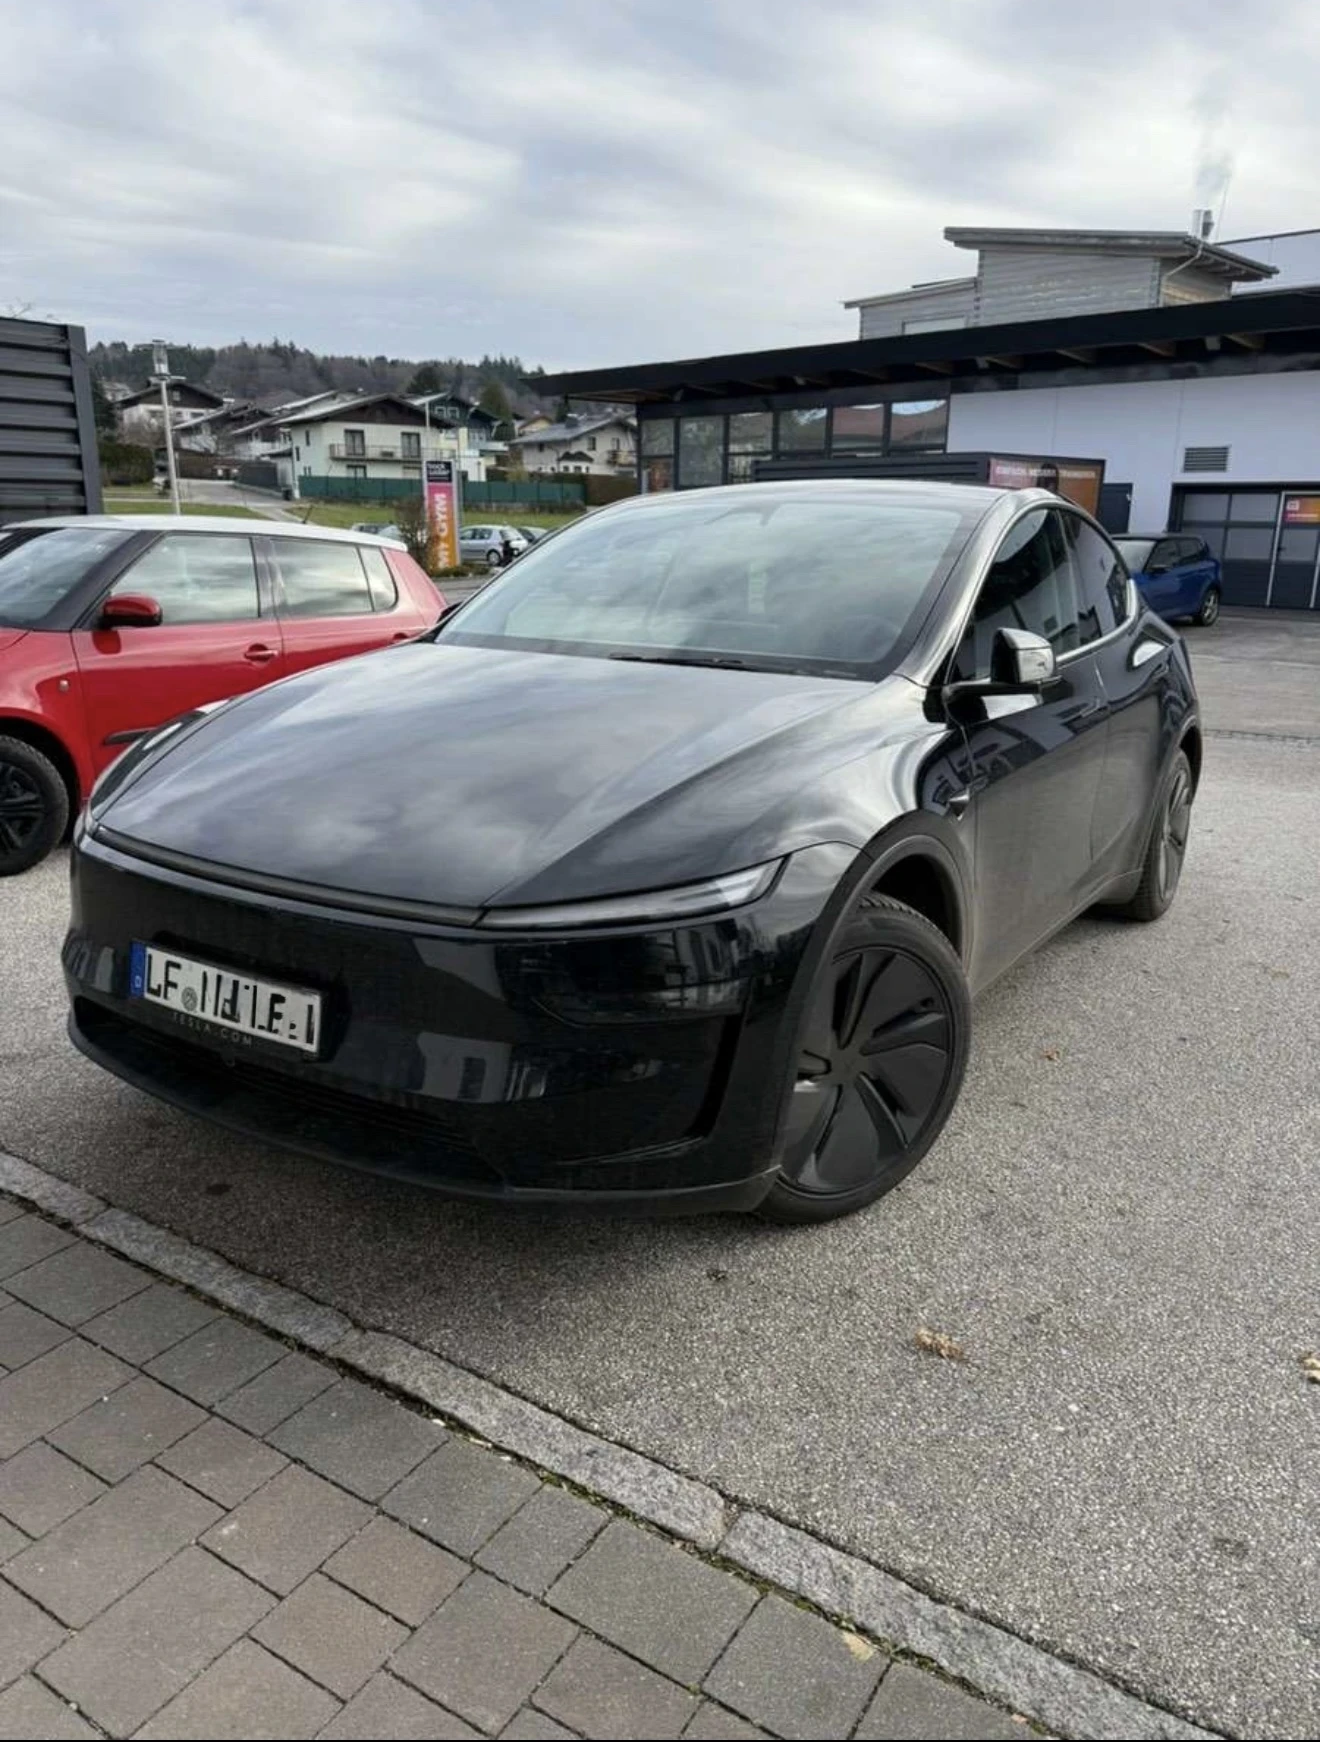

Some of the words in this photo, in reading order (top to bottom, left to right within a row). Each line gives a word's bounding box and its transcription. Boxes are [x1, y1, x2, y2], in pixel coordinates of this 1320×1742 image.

[434, 493, 448, 537] GYM
[436, 542, 450, 569] MY
[172, 1011, 252, 1046] TESLA.COM
